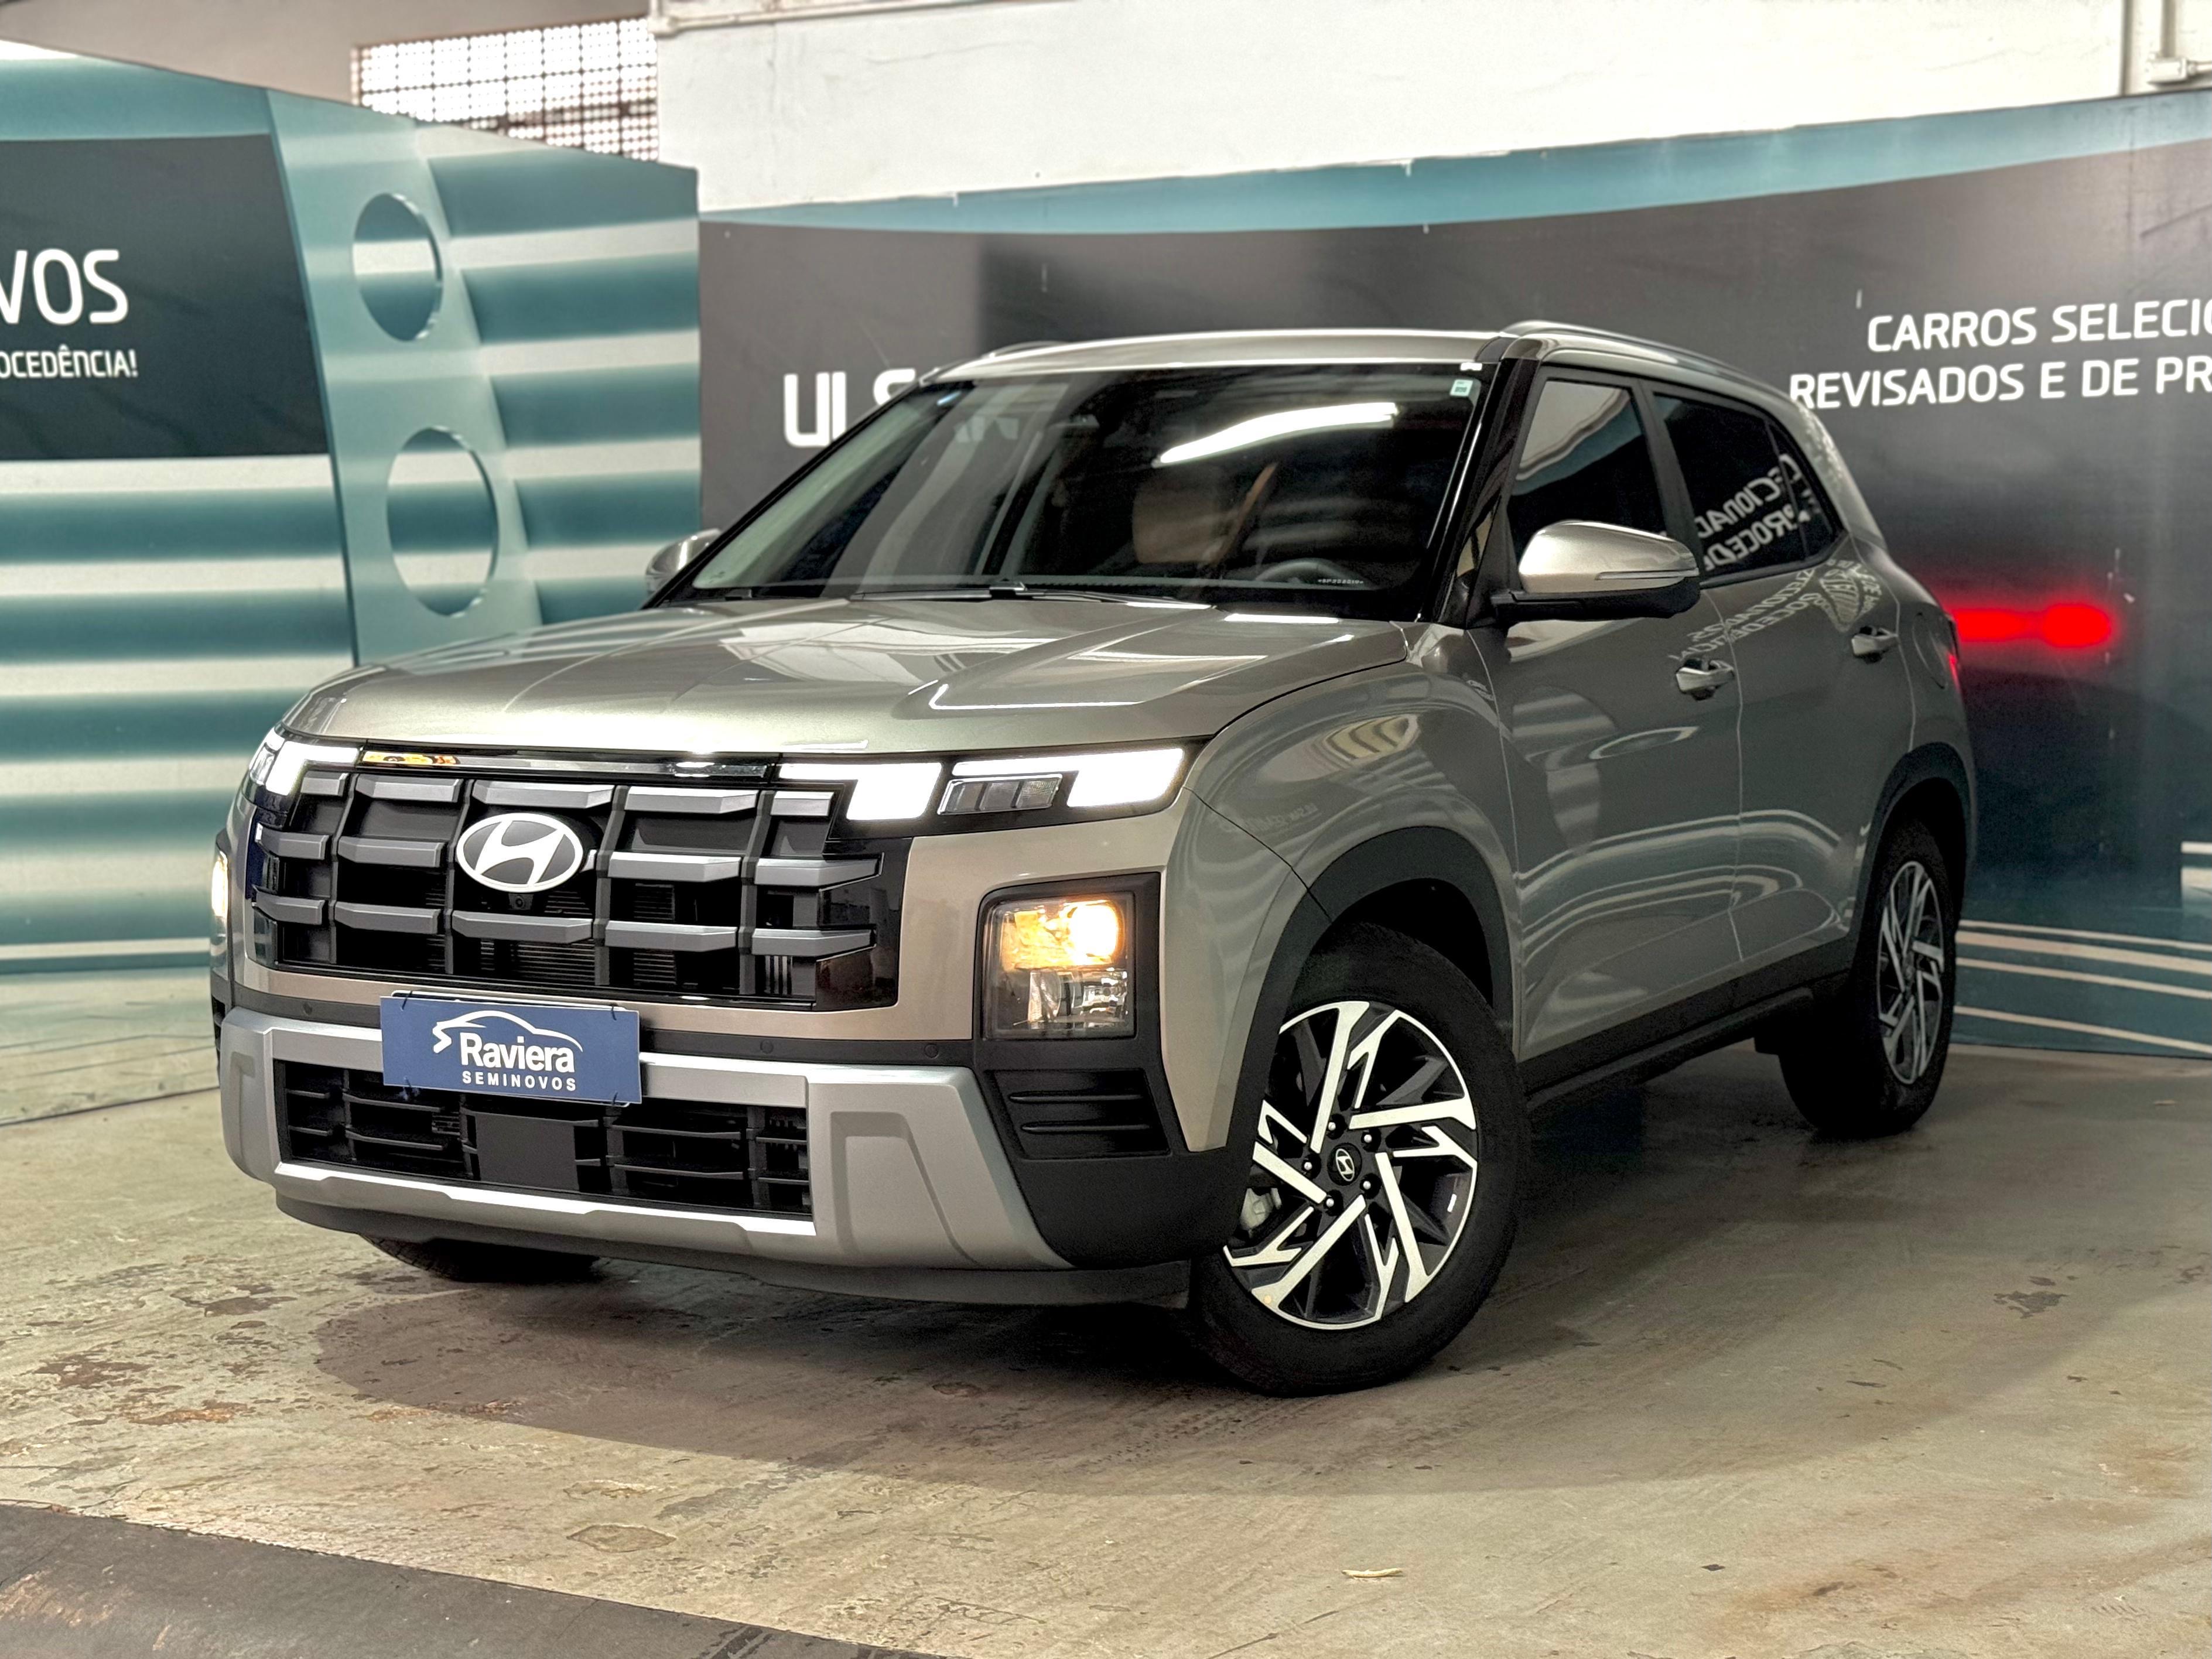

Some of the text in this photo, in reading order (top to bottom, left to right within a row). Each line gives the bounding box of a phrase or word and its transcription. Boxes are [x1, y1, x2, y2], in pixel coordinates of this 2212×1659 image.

[0, 248, 128, 324] VOS
[1868, 307, 2037, 352] CARROS
[1790, 355, 2212, 409] REVISADOS E DE PR
[460, 1032, 575, 1073] Raviera
[462, 1070, 576, 1092] SEMINOVOS
